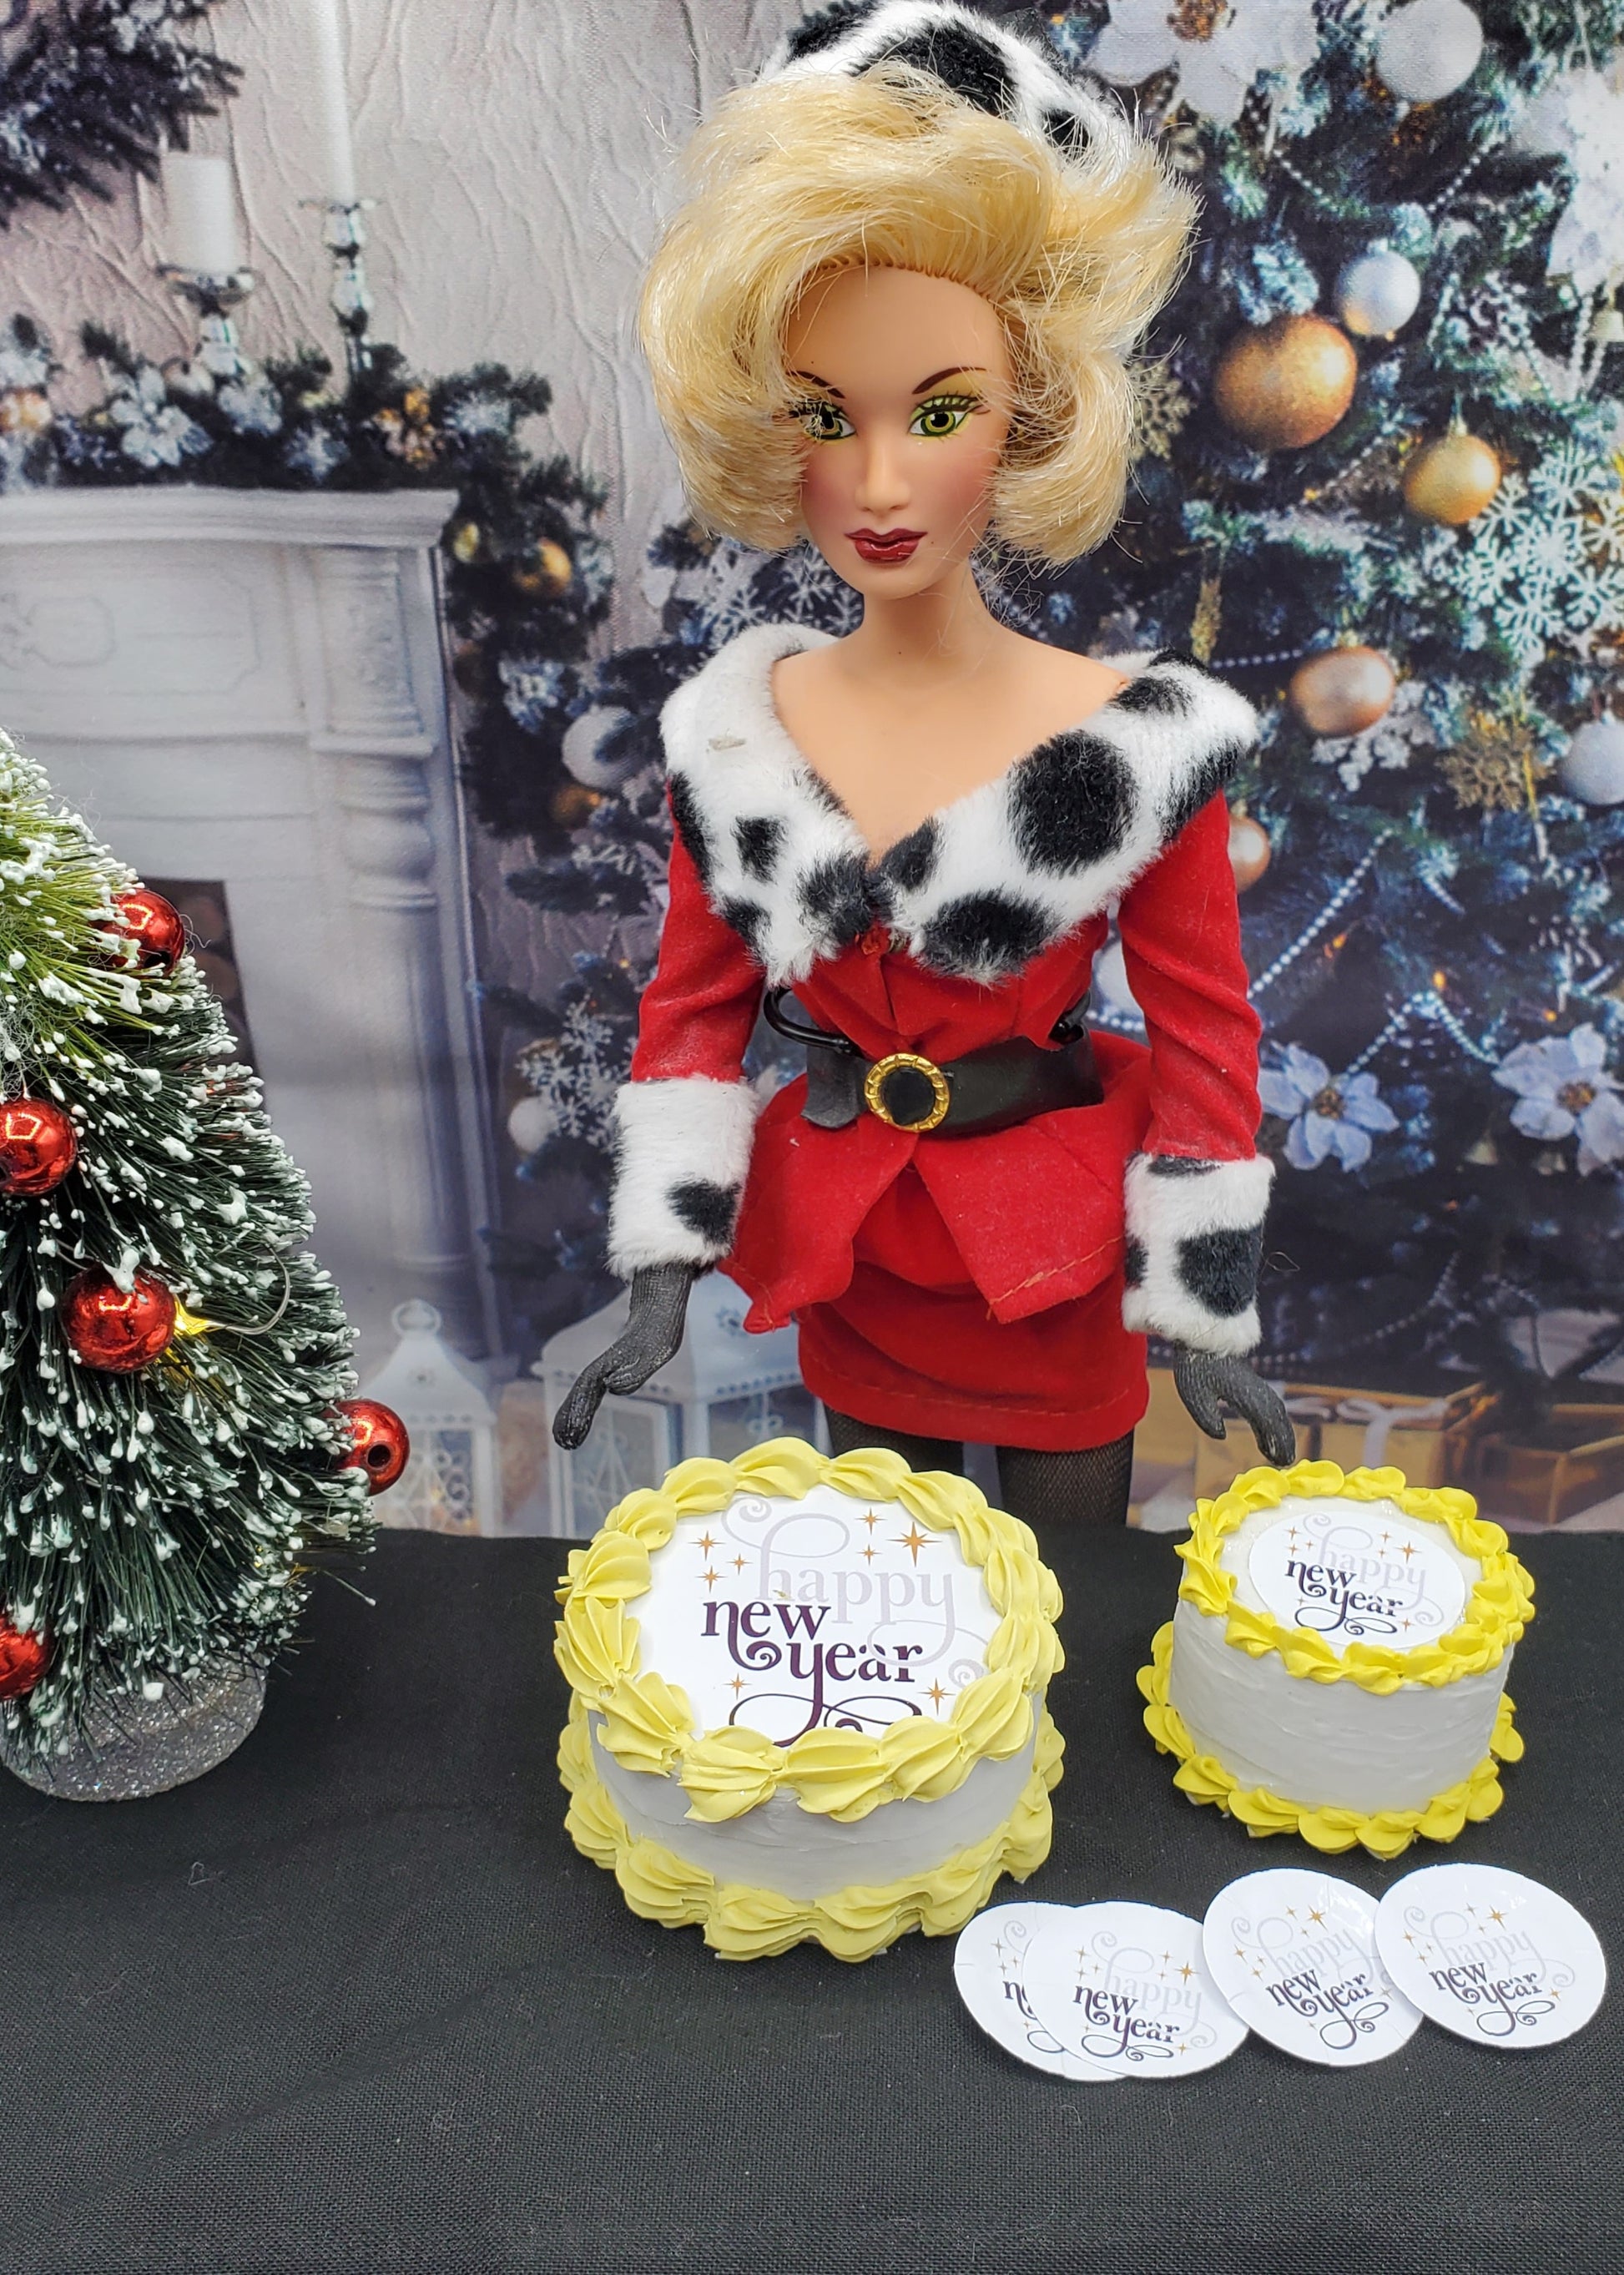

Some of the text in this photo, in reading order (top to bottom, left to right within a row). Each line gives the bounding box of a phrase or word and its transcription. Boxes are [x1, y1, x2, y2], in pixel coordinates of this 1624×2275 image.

[1285, 1559, 1357, 1597] new
[701, 1600, 831, 1671] new
[1265, 1969, 1322, 2017] new
[1429, 1962, 1488, 2004] new
[1073, 1985, 1139, 2025] new
